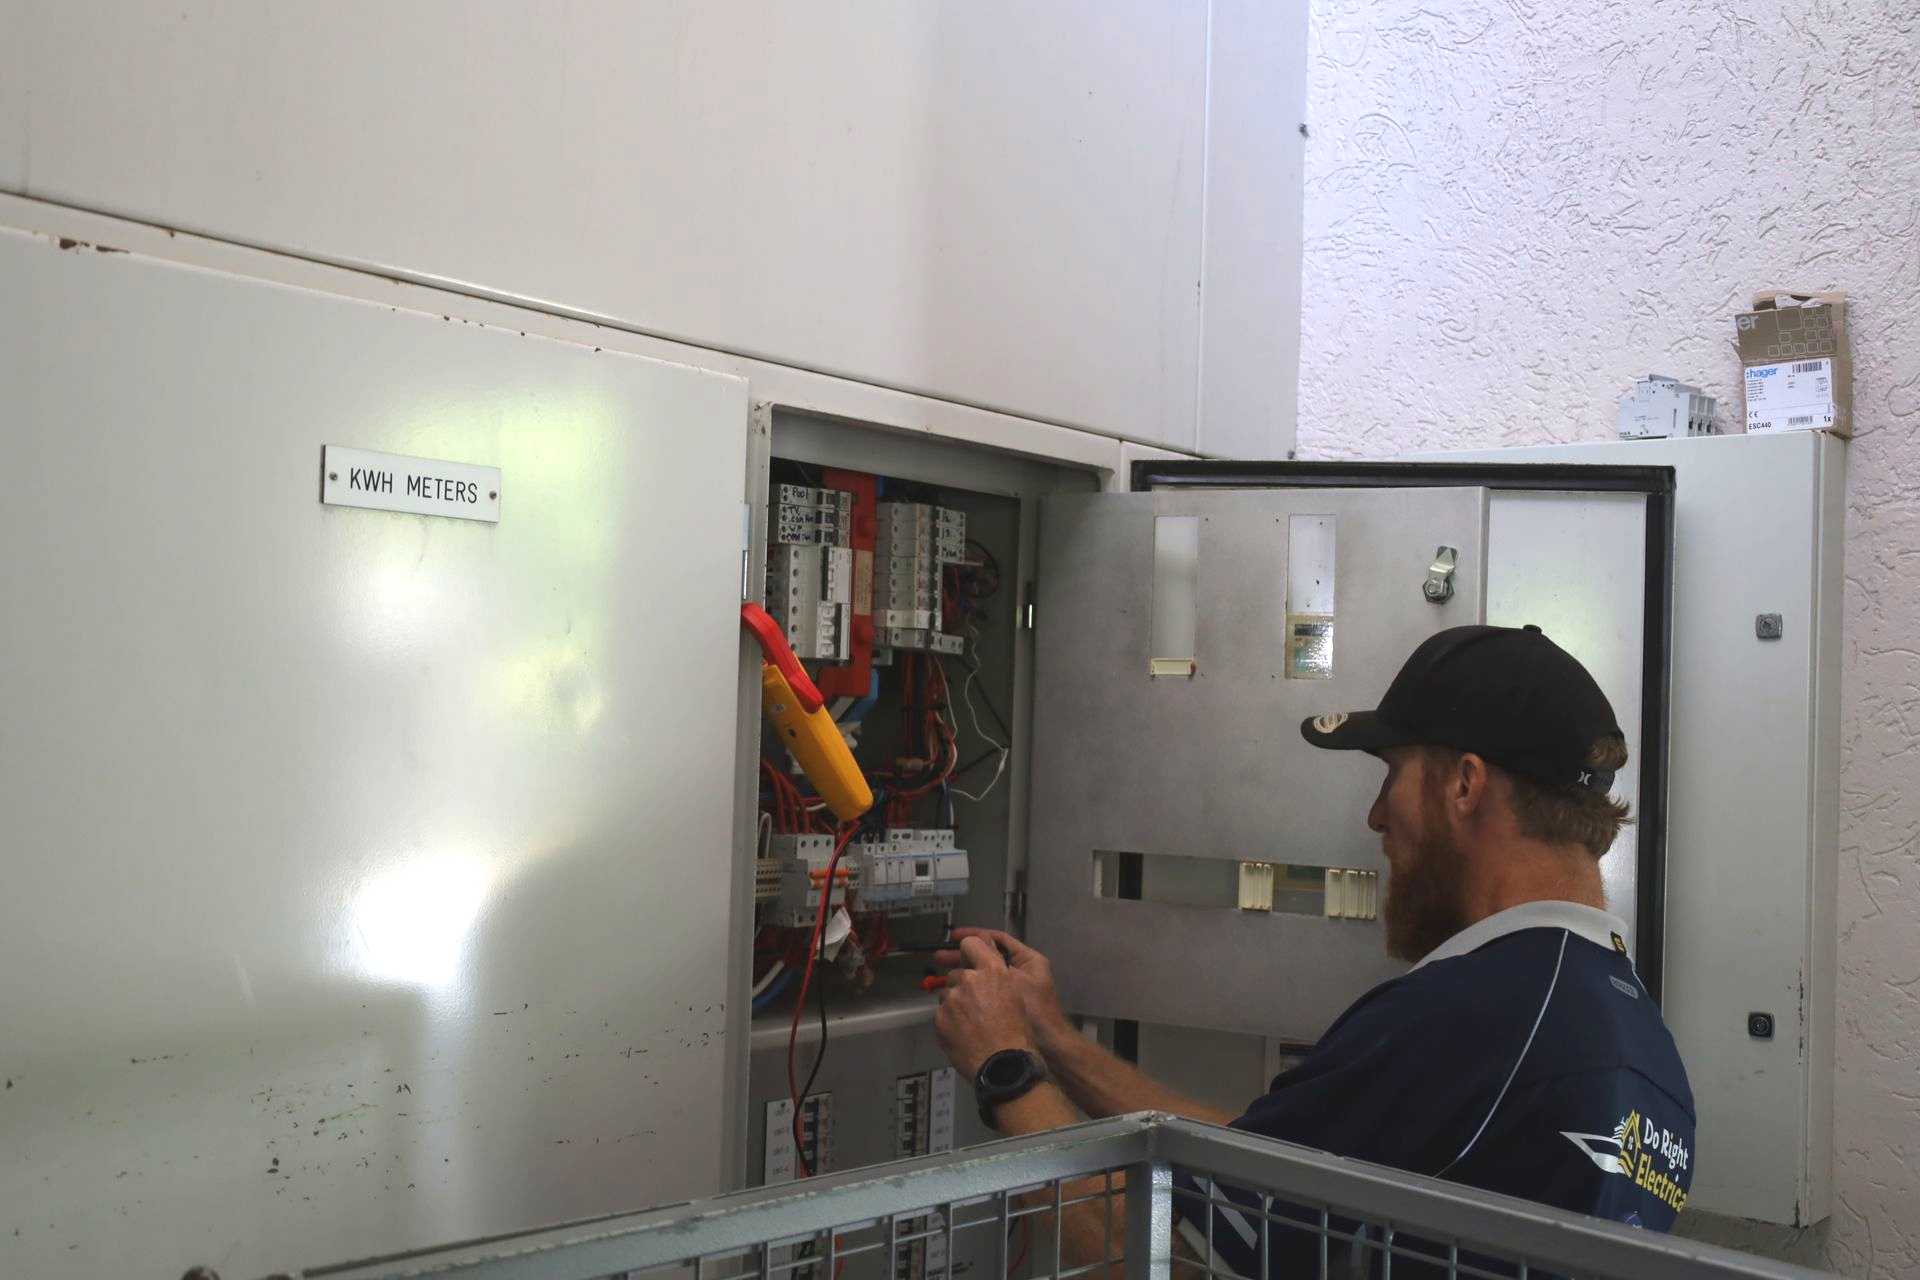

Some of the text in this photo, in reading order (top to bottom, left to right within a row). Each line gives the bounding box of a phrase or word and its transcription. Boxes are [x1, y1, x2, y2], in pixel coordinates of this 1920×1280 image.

[1748, 422, 1772, 430] ESC440
[350, 467, 478, 504] KWH METERS
[1643, 1117, 1689, 1171] Do Right
[1635, 1152, 1688, 1213] Electrica
